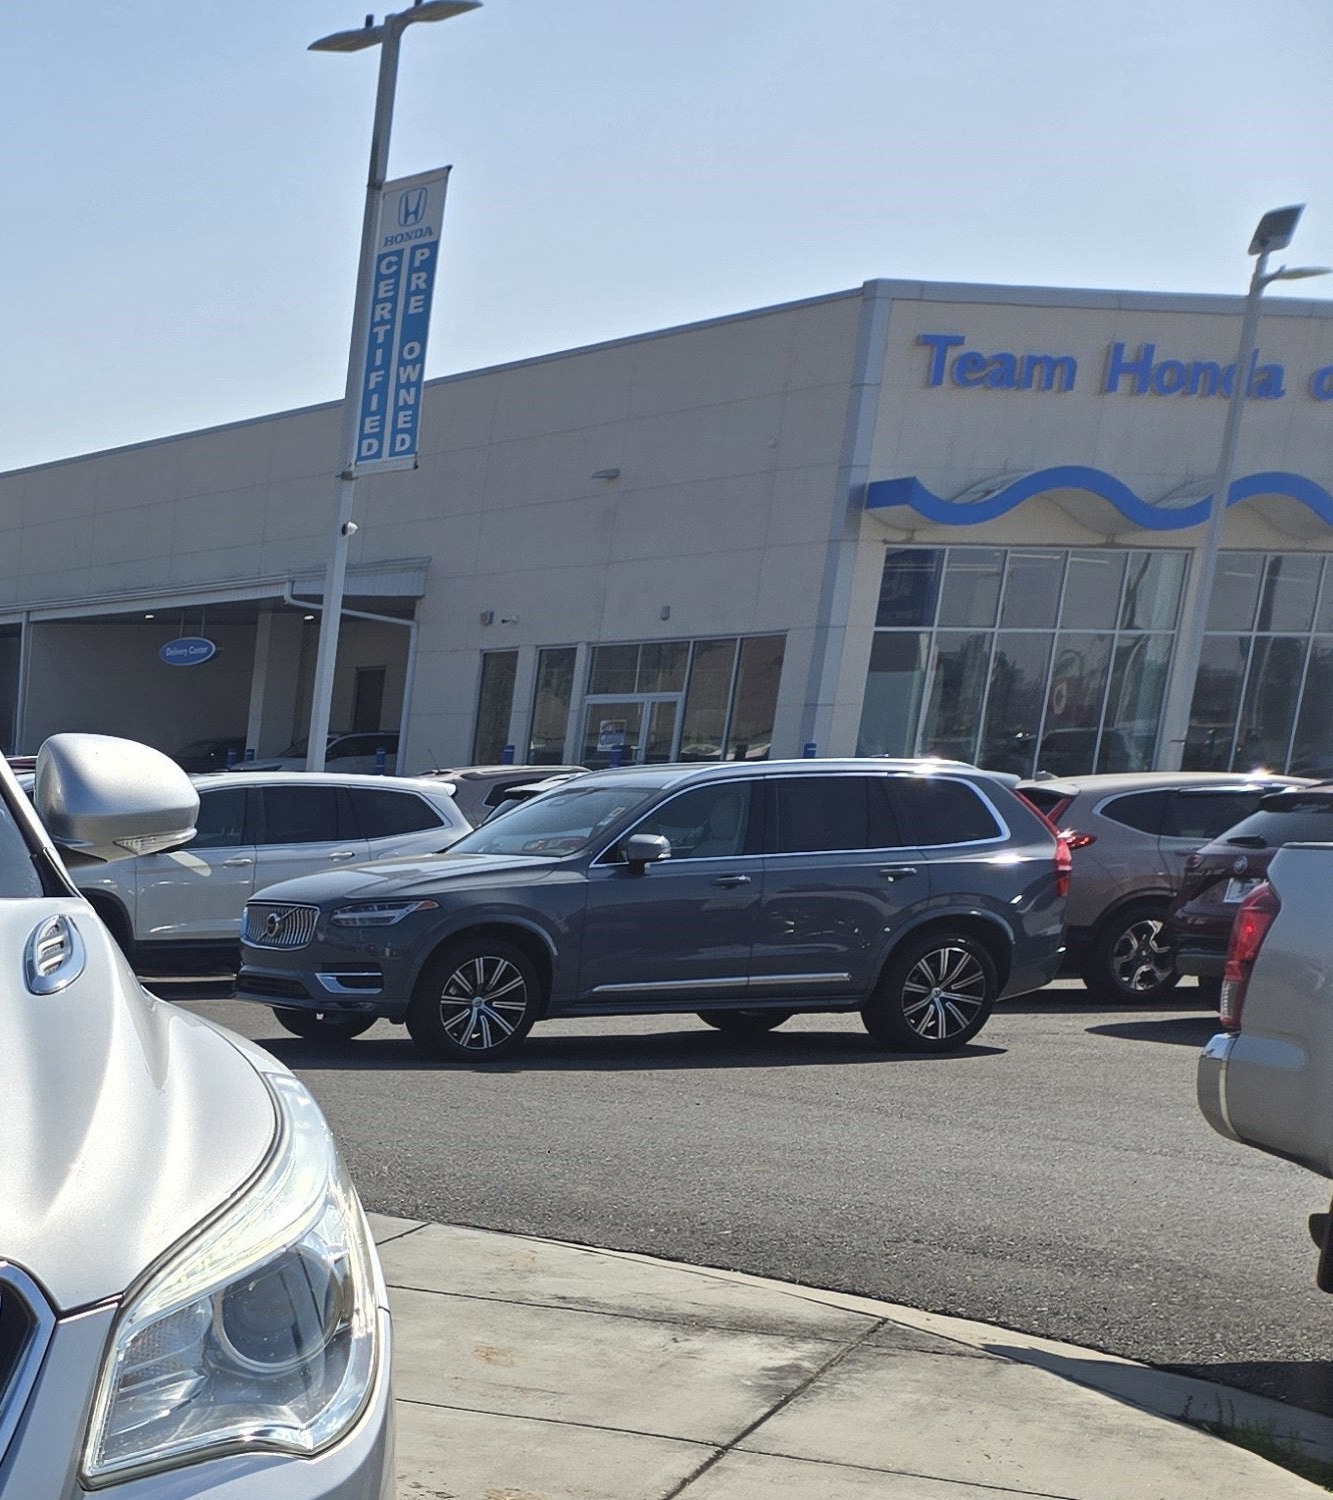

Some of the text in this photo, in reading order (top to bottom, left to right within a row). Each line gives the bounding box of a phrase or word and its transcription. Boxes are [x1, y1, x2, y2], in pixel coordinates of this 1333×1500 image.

[384, 226, 434, 247] HONDA
[360, 256, 399, 457] CERTIFIED
[394, 248, 430, 453] PRE OWNED
[918, 333, 1078, 393] Team
